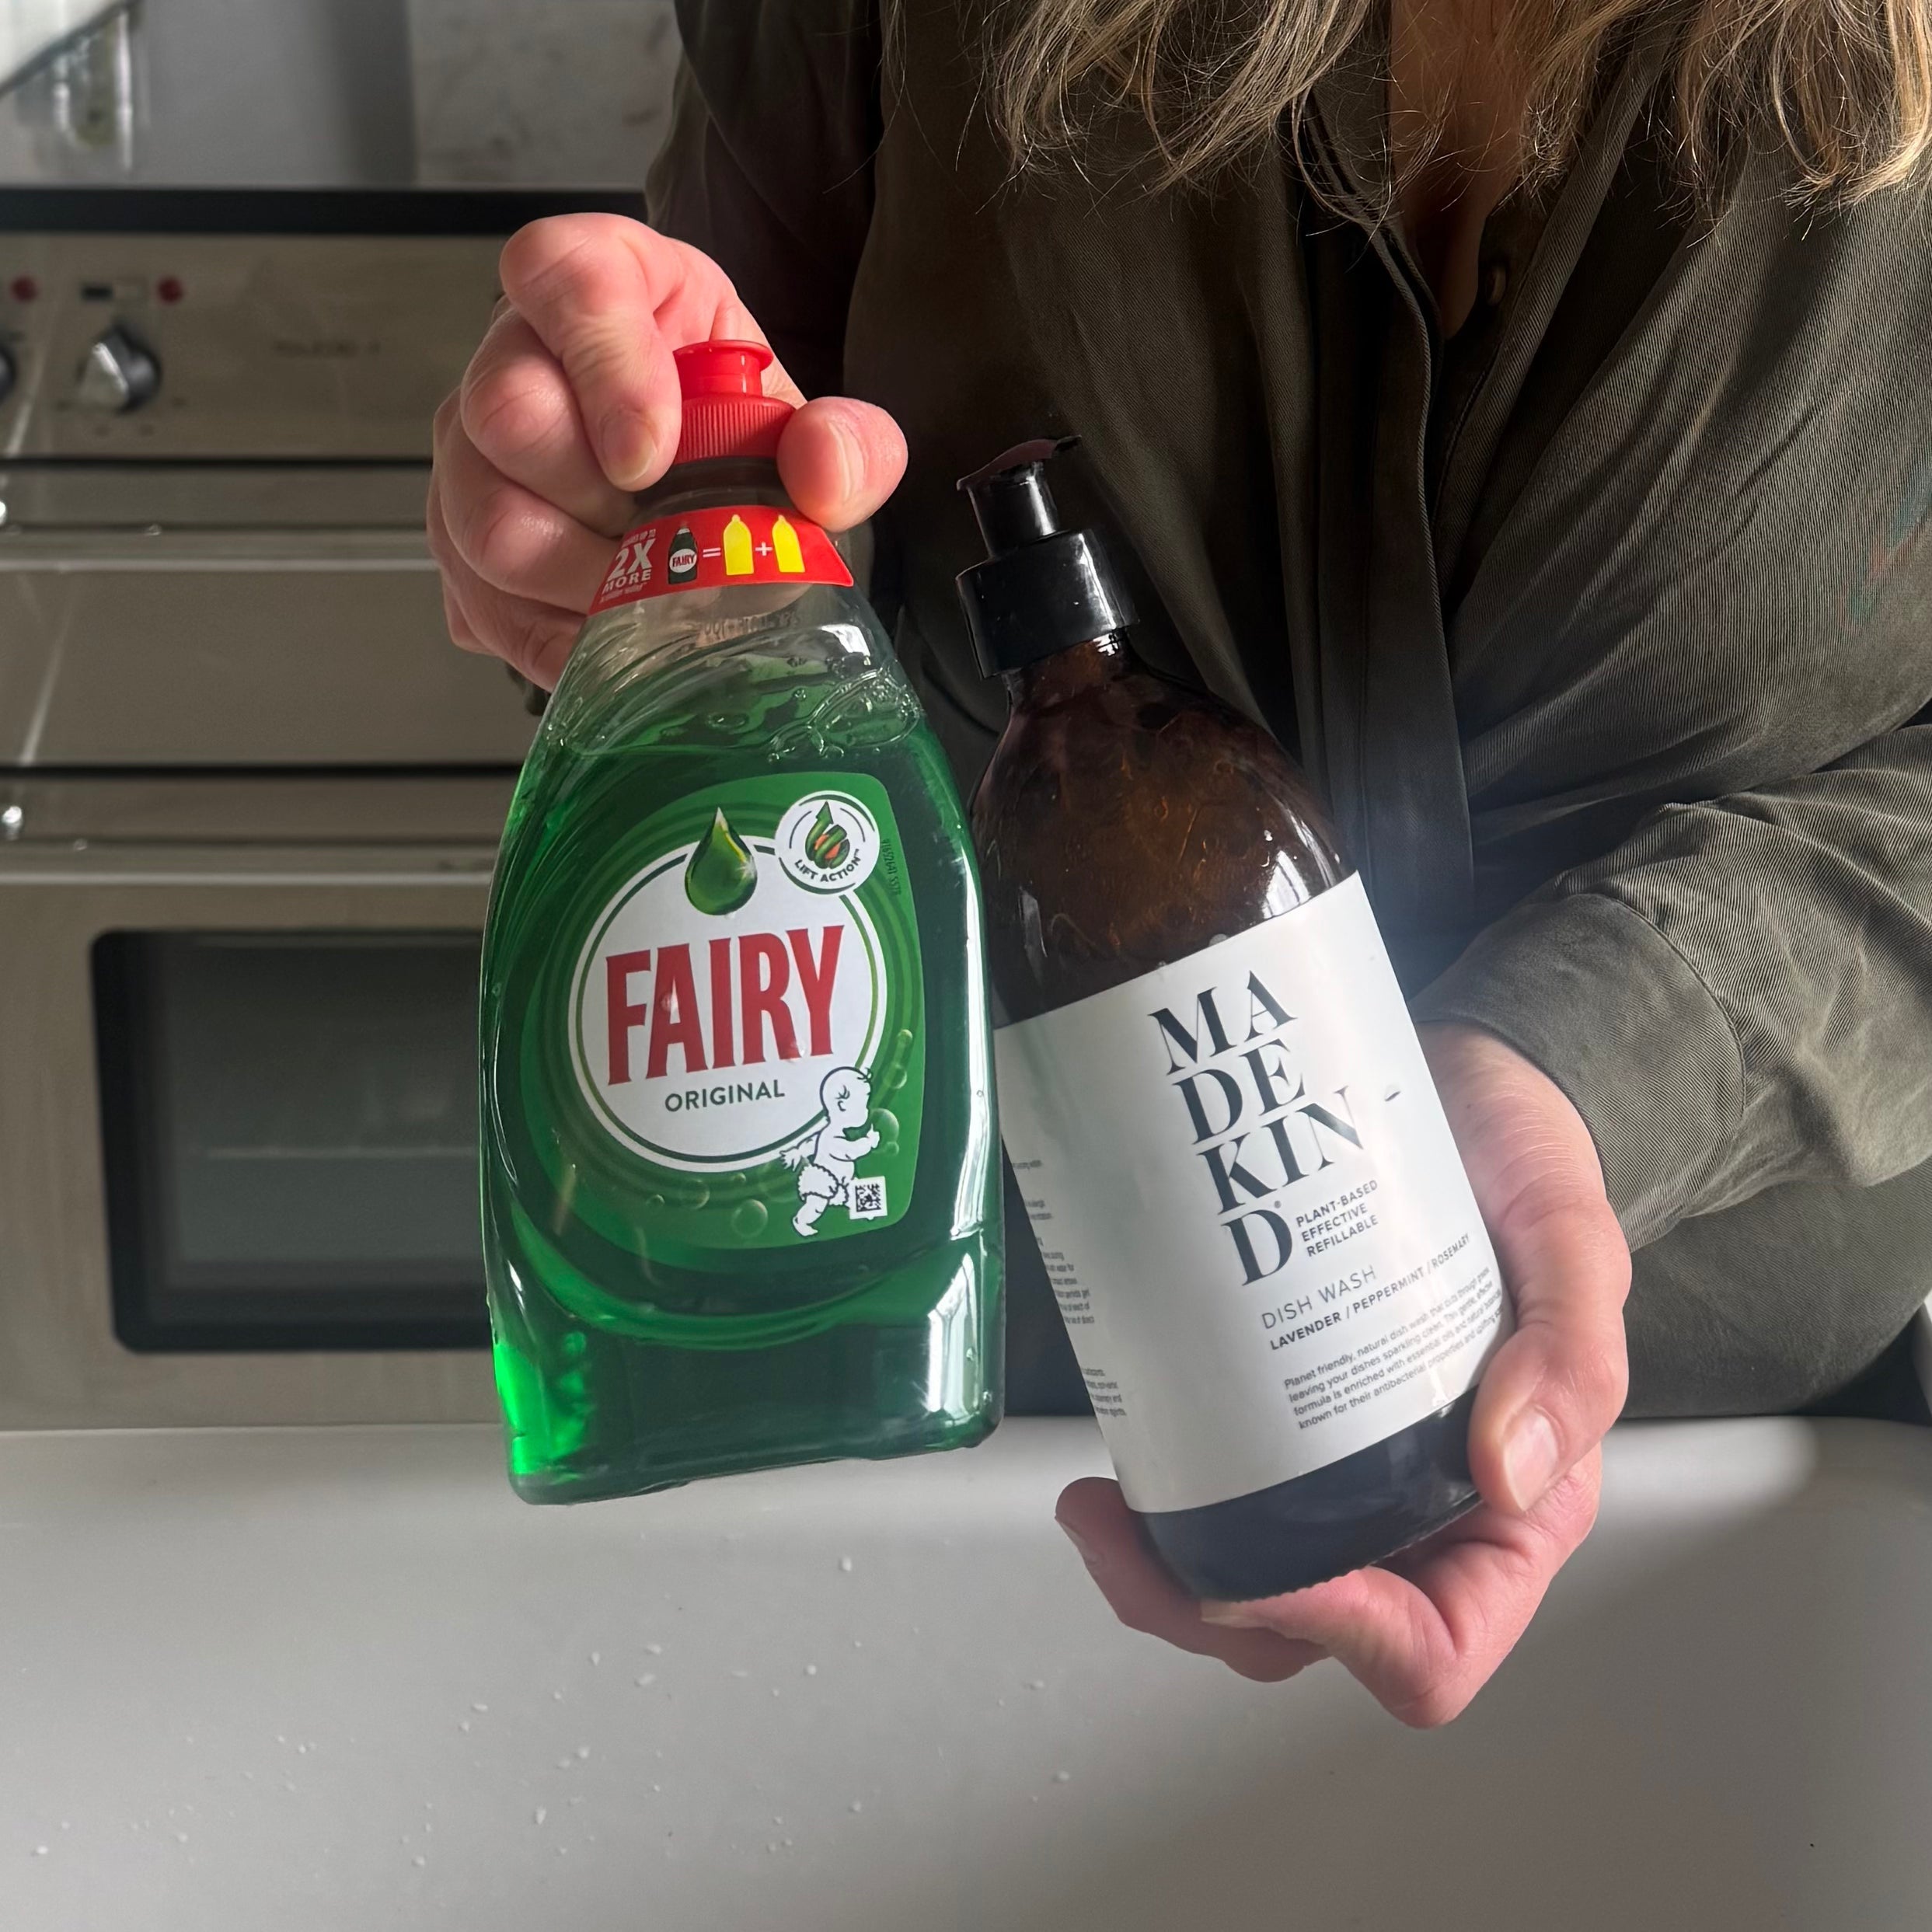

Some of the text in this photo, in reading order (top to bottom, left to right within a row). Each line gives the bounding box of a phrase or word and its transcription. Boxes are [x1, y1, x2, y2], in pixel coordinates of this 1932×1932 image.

[602, 569, 652, 595] MORE
[606, 538, 656, 582] 2X
[671, 553, 697, 567] FAIRY
[794, 859, 818, 879] LIFT
[605, 925, 845, 1086] FAIRY
[1147, 970, 1298, 1076] MA
[664, 1079, 785, 1112] ORIGINAL
[1171, 1038, 1305, 1145] DE
[1196, 1086, 1364, 1215] KIN
[1296, 1180, 1378, 1227] PLANT-BASED
[1301, 1203, 1368, 1242] EFFECTIVE
[1306, 1215, 1379, 1257] REFILLABLE
[1261, 1264, 1376, 1329] DISH WASH
[1270, 1312, 1341, 1350] LAVENDER
[1352, 1266, 1425, 1313] PEPPERMINT
[1431, 1233, 1470, 1270] ROSEMARY
[1284, 1369, 1316, 1390] Planet
[1358, 1334, 1389, 1357] natural
[1390, 1325, 1408, 1341] dish
[1289, 1382, 1326, 1403] leaving
[1326, 1372, 1348, 1389] your
[1351, 1355, 1381, 1376] dishes
[1294, 1394, 1332, 1416] formula
[1334, 1390, 1342, 1400] is
[1344, 1369, 1385, 1395] enriched
[1386, 1358, 1405, 1374] with
[1298, 1411, 1333, 1430] known
[1334, 1403, 1348, 1415] for
[1349, 1392, 1372, 1408] their
